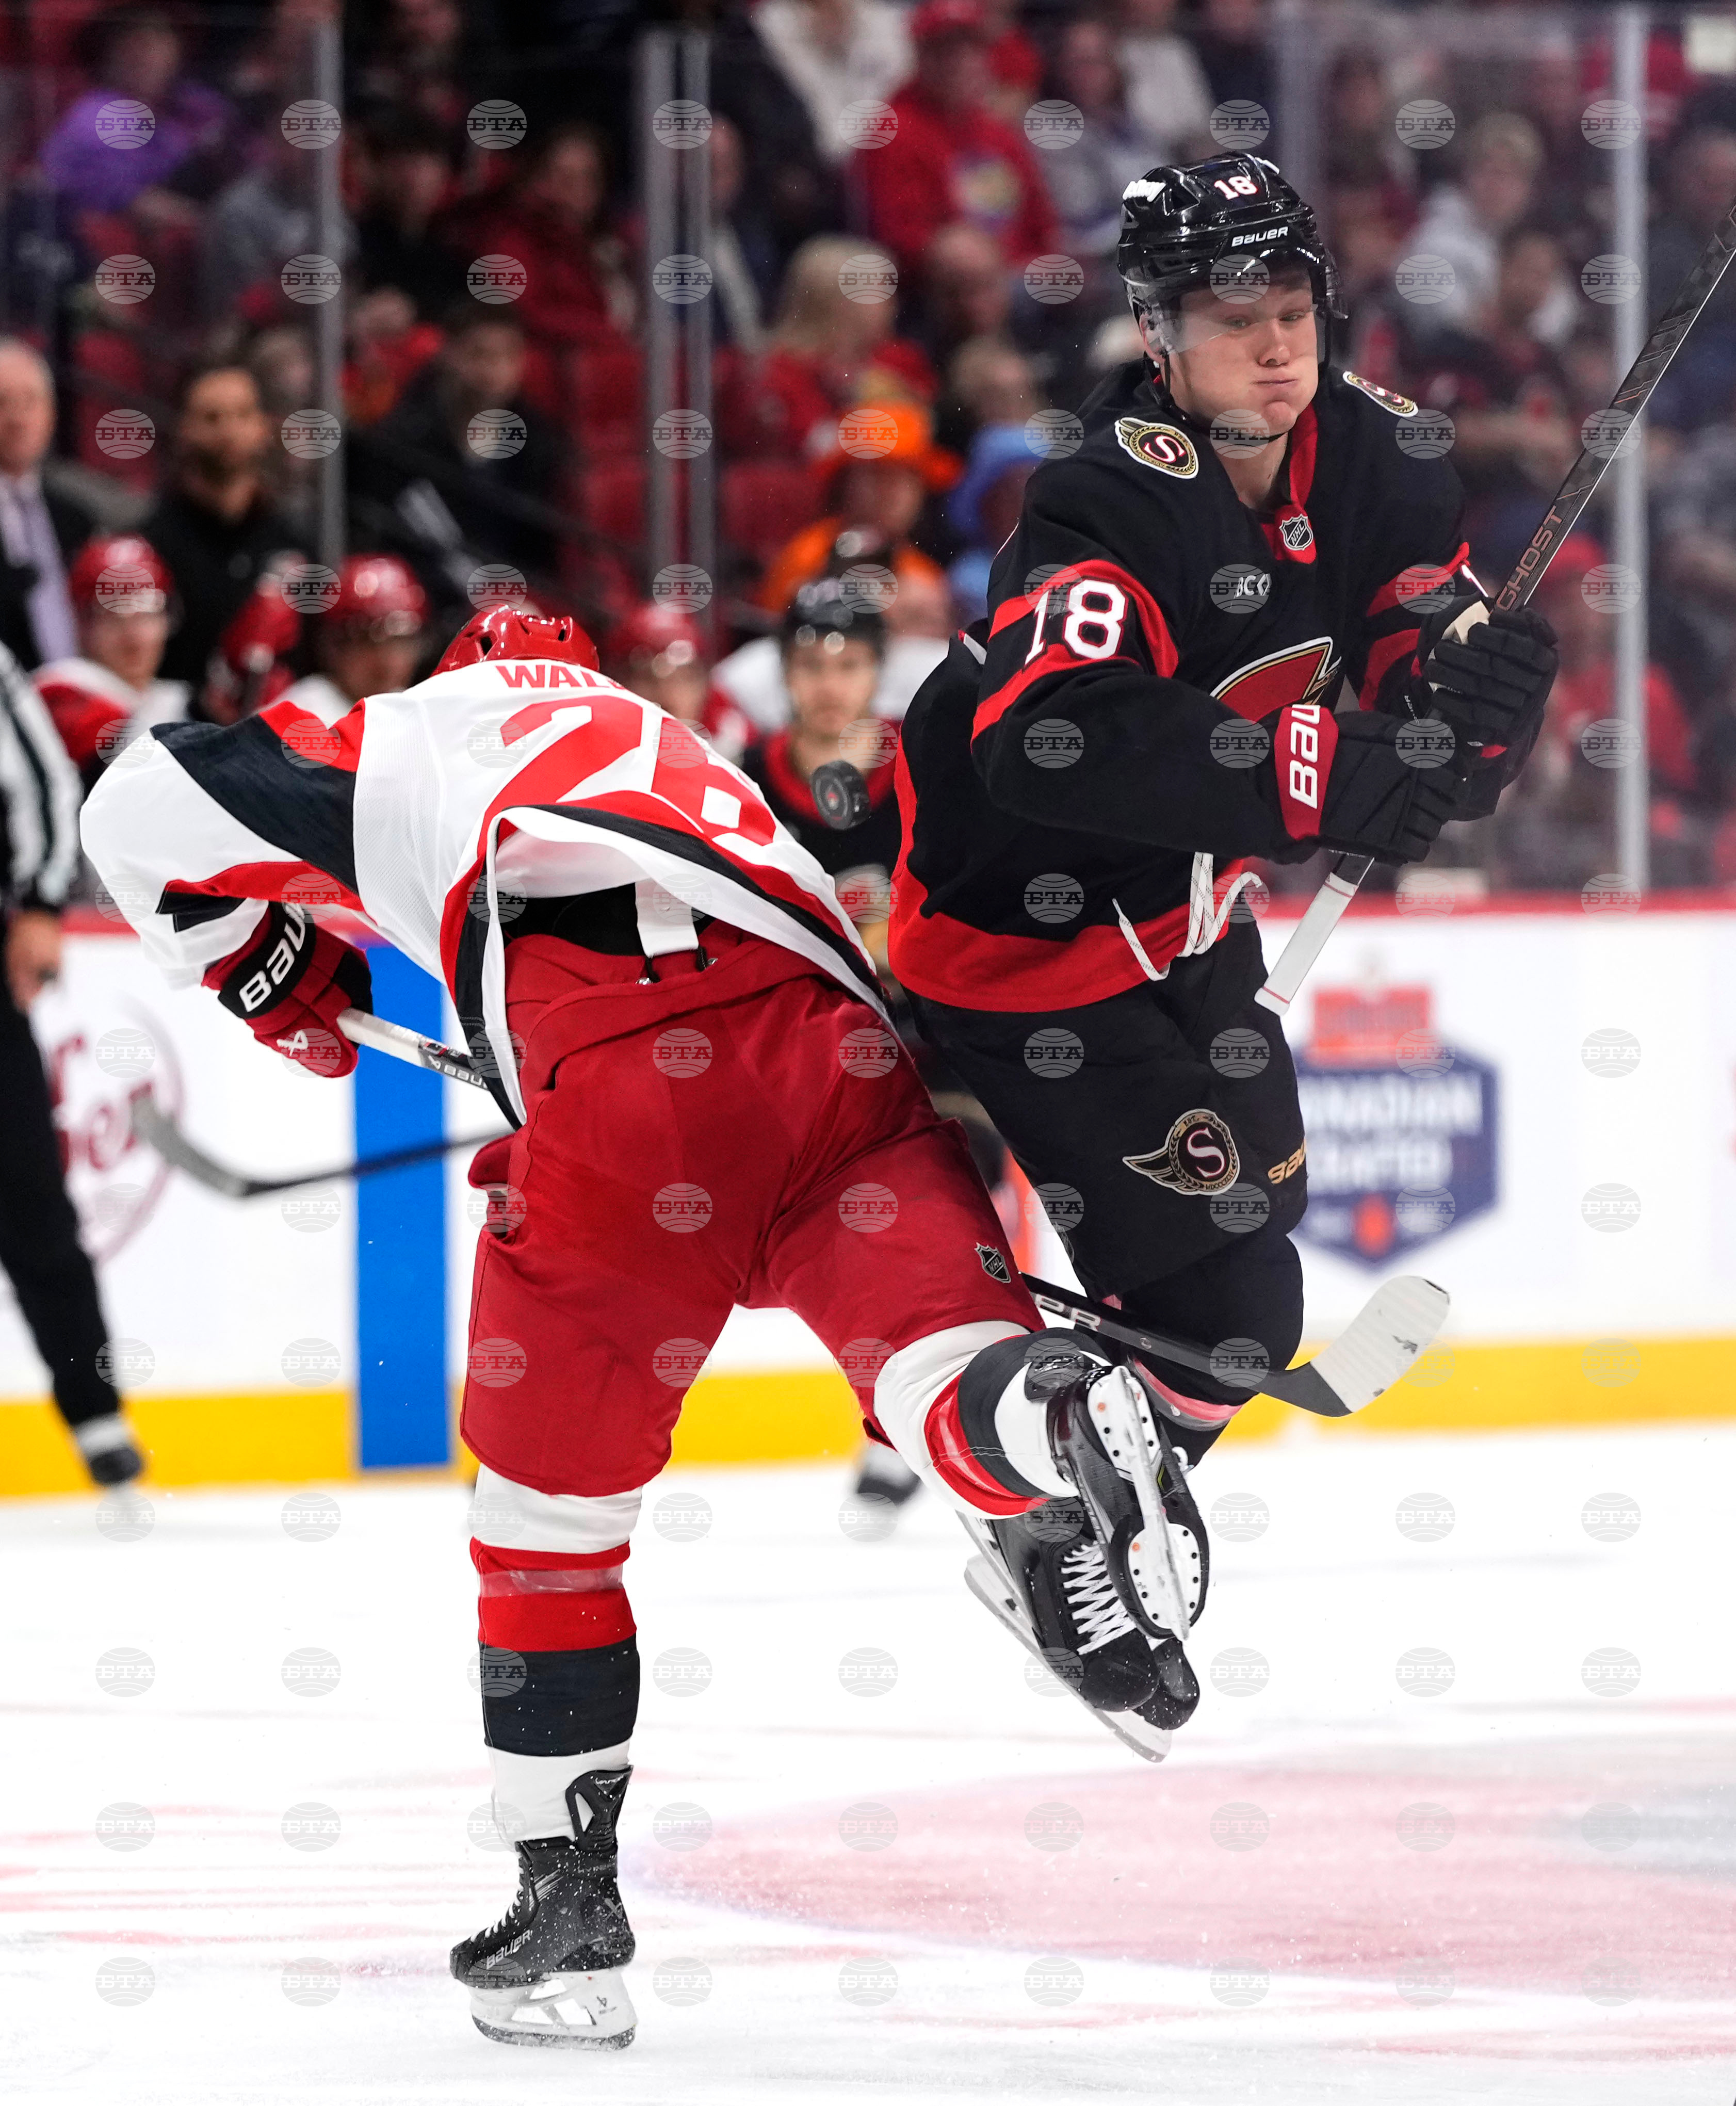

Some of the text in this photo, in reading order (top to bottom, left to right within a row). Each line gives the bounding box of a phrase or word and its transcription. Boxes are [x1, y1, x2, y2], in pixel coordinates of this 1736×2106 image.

[1214, 175, 1258, 200] 18
[1290, 523, 1305, 545] NHL
[1496, 505, 1563, 611] GHOST
[1024, 578, 1128, 666] 18
[987, 1256, 1002, 1274] NHL
